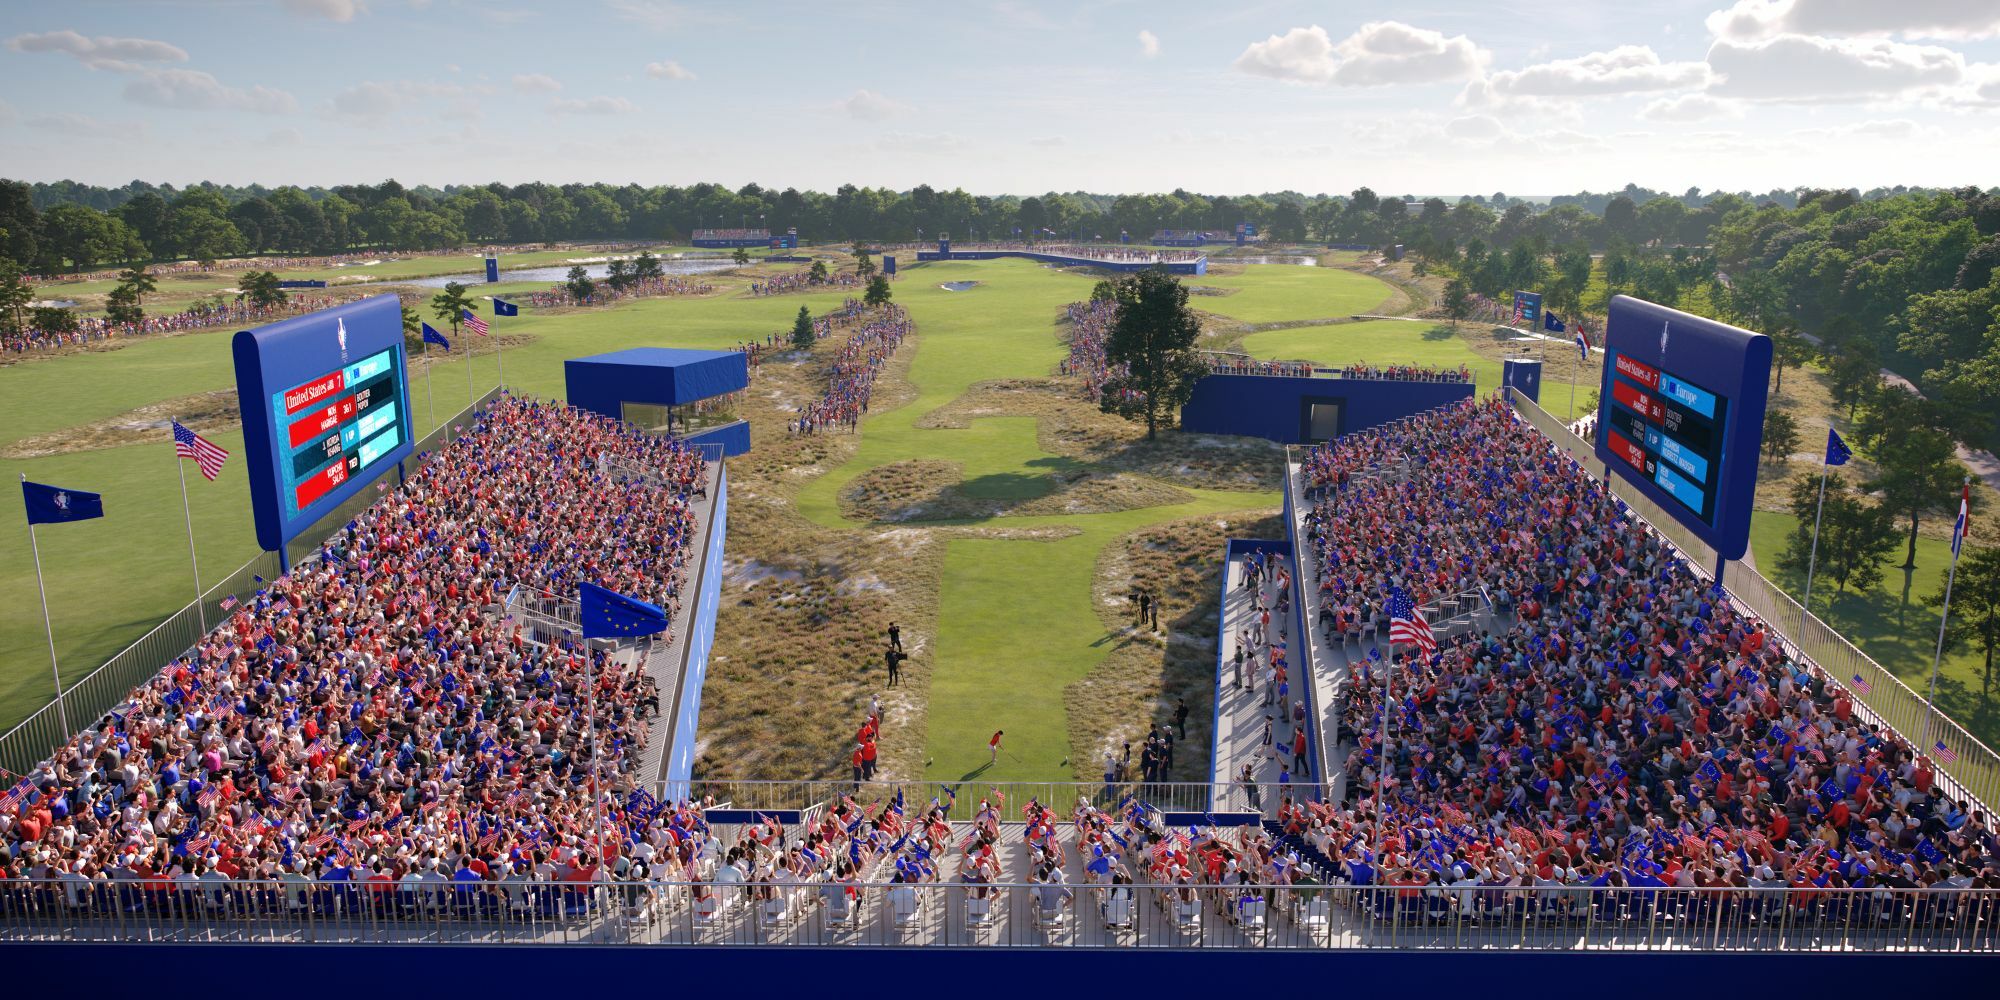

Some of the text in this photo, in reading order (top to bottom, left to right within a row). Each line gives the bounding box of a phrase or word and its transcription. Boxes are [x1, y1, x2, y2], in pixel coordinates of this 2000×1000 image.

[287, 375, 341, 409] United States 7
[1654, 374, 1658, 386] 7
[1662, 378, 1697, 405] 9 Europe
